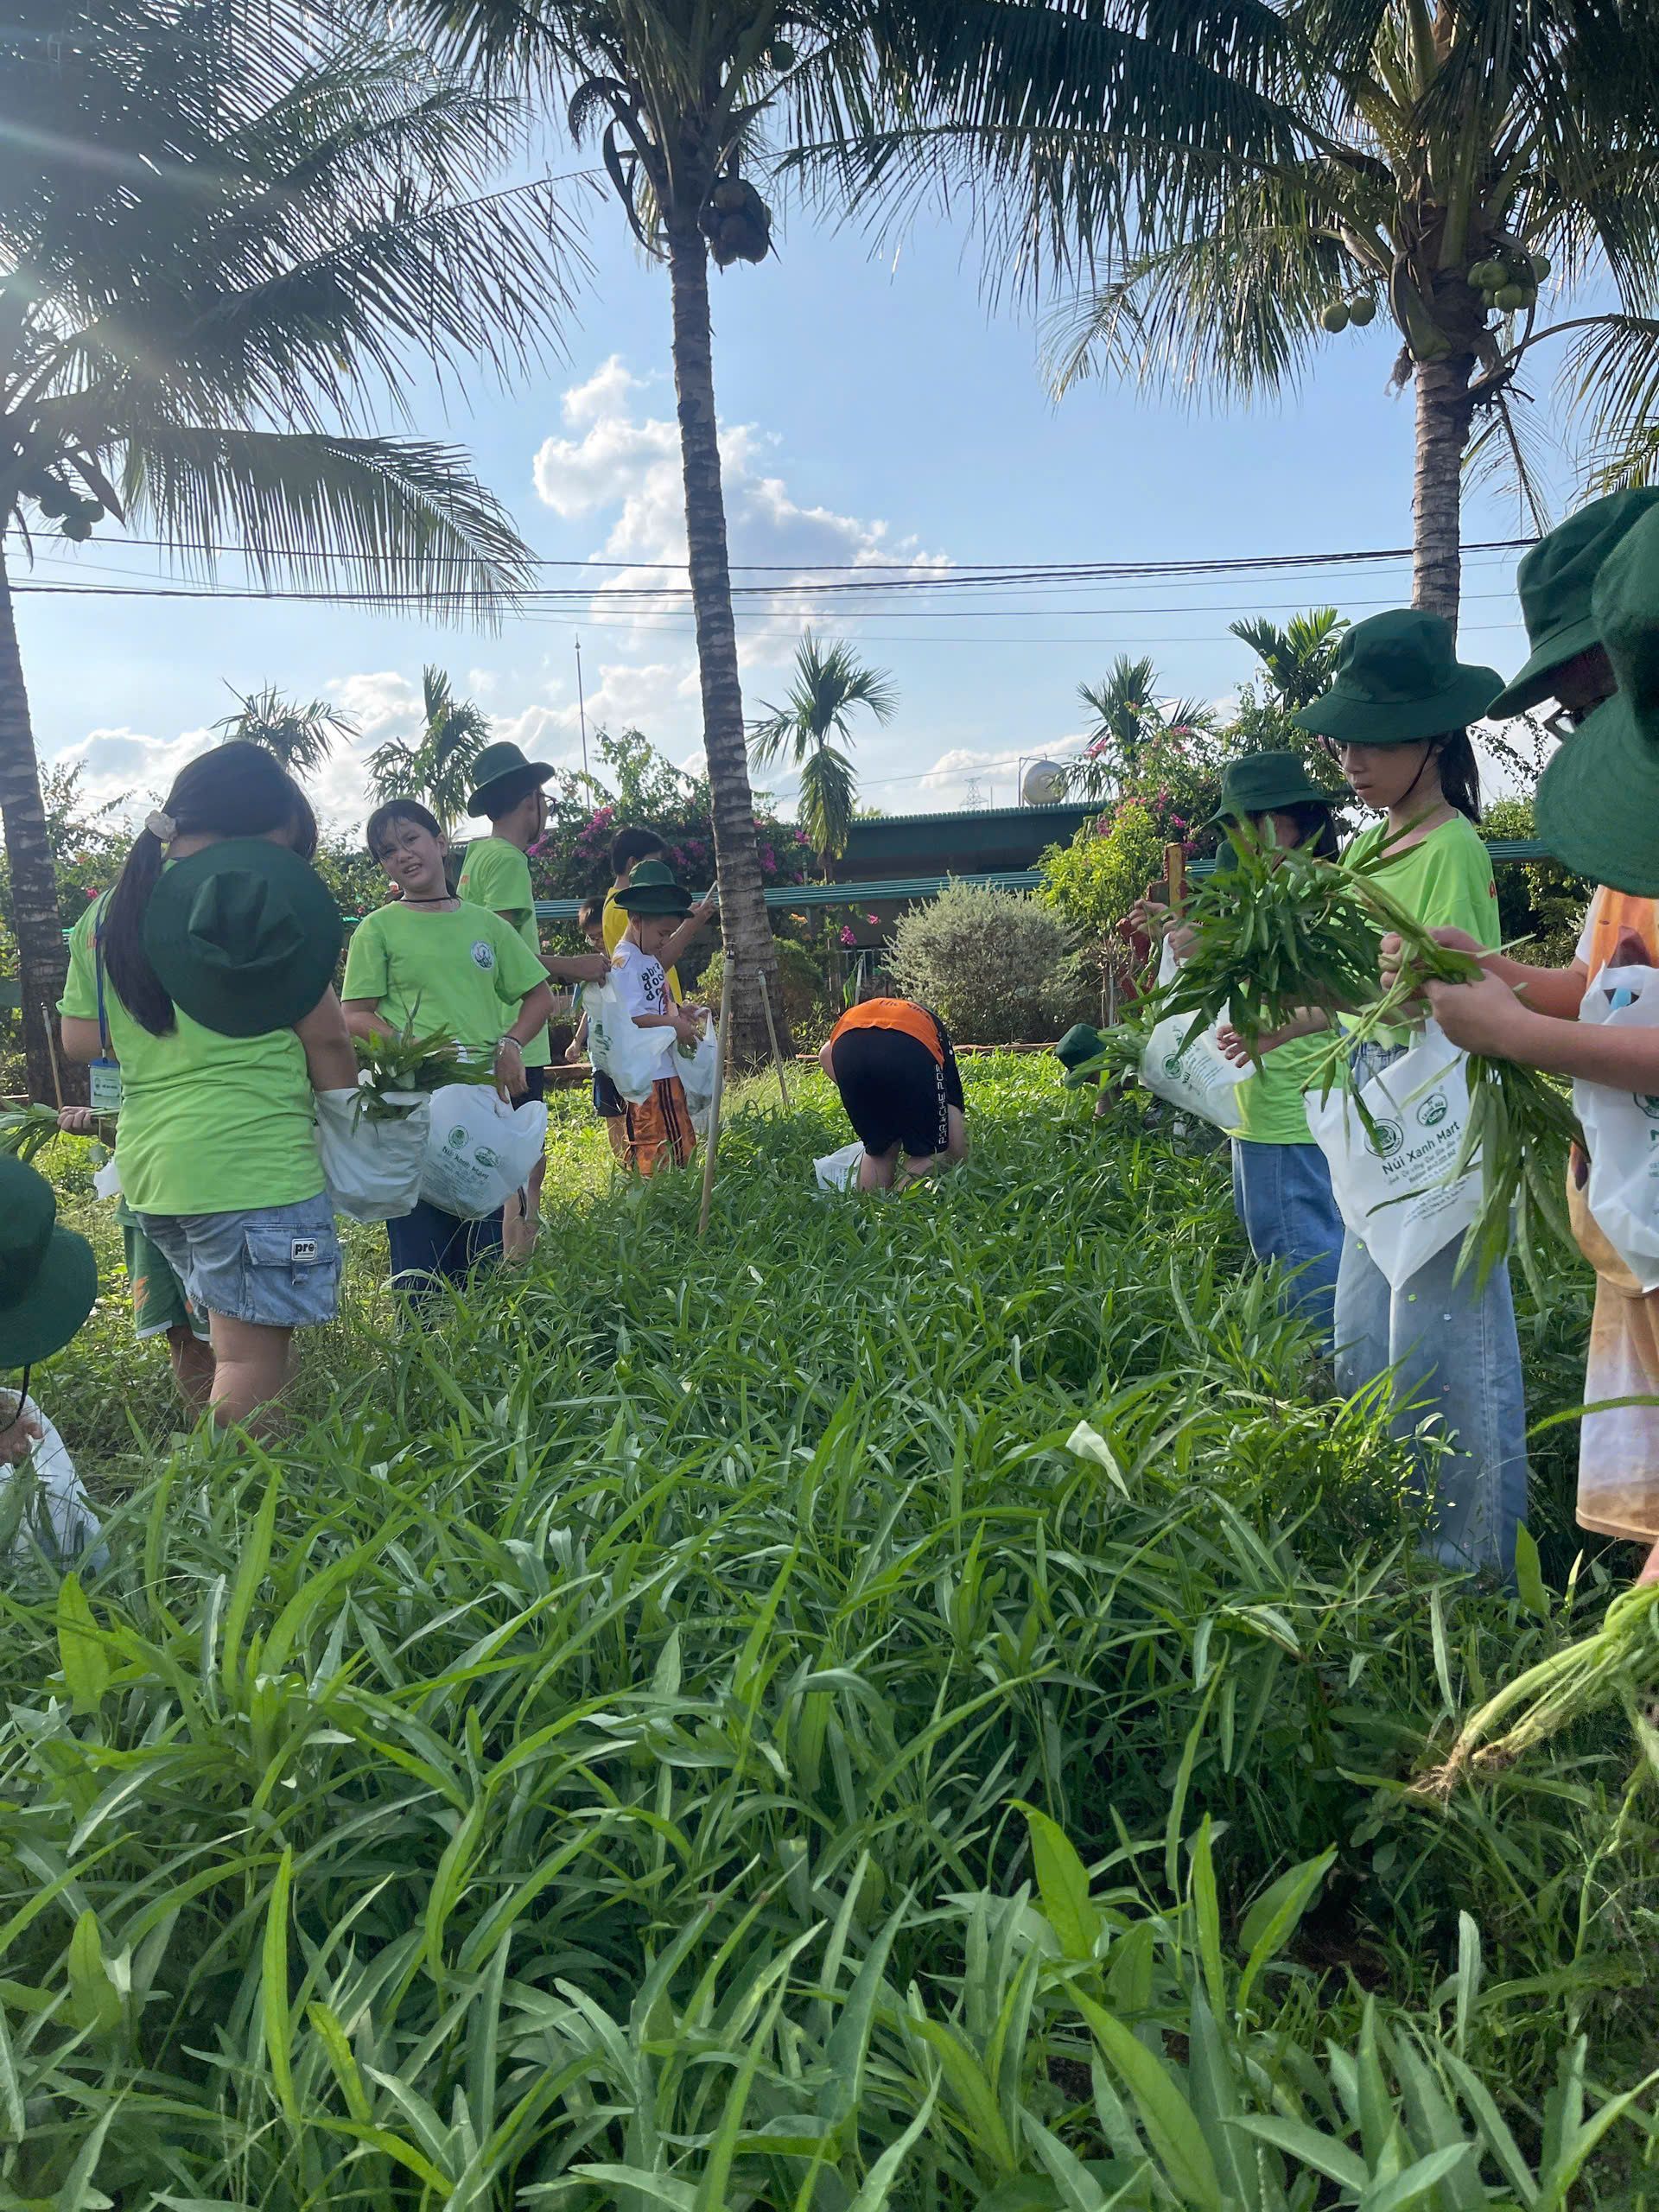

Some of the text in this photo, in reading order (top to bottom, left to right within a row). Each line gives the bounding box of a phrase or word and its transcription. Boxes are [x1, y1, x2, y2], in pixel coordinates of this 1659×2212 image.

[1382, 1155, 1405, 1175] Núi
[1406, 1139, 1436, 1163] Xanh
[1436, 1121, 1460, 1143] Mart
